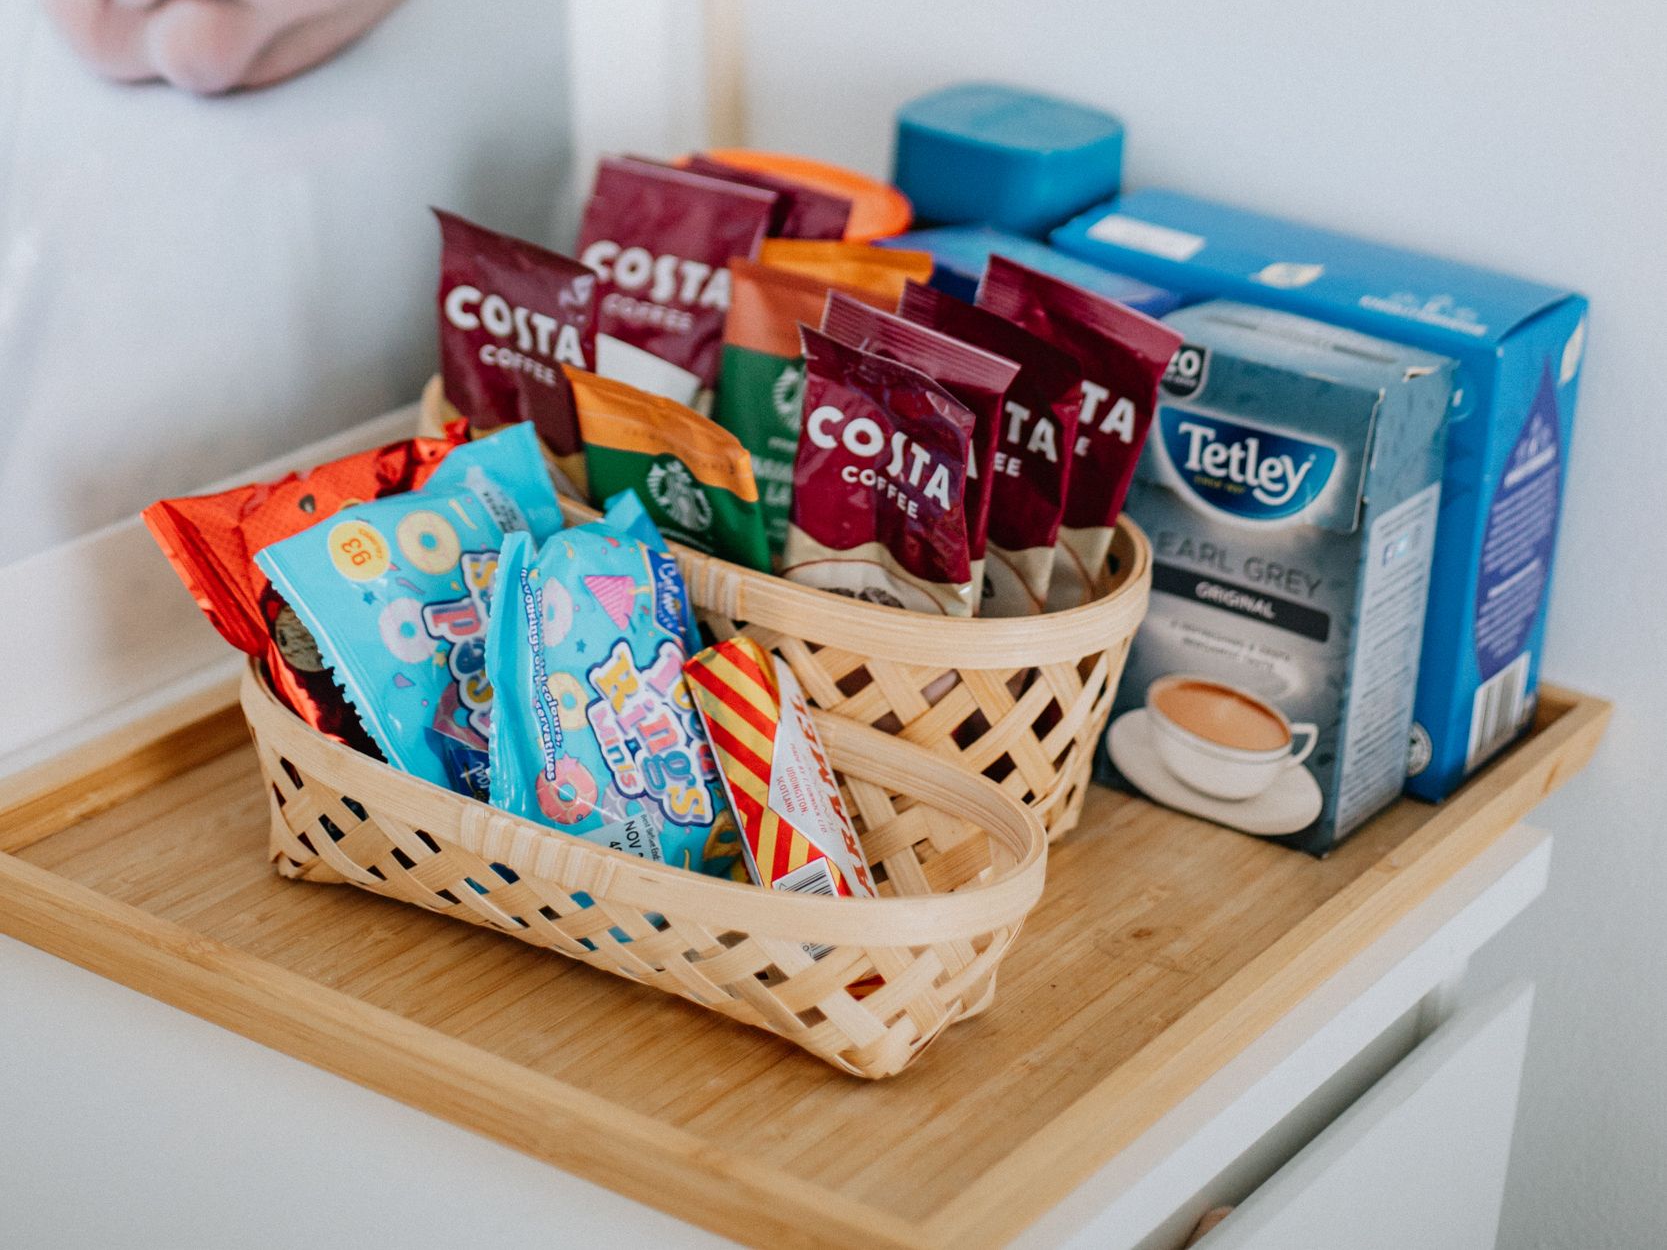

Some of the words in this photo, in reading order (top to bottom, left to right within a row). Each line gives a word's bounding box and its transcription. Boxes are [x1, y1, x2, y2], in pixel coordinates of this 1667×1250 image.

[581, 240, 731, 311] COSTA
[445, 285, 587, 368] COSTA
[479, 344, 556, 386] COFFEE
[807, 405, 950, 510] COSTA
[841, 465, 918, 519] COFFEE
[1178, 421, 1316, 505] Tetley
[341, 538, 371, 566] 93
[1155, 531, 1233, 574] EARL
[1243, 555, 1322, 599] GREY
[1195, 581, 1276, 619] ORIGINAL
[592, 707, 638, 788] Minis
[594, 650, 706, 816] Rings
[776, 775, 795, 814] SCOTLAND
[790, 695, 876, 899] ARAMEL
[624, 820, 642, 848] NOV
